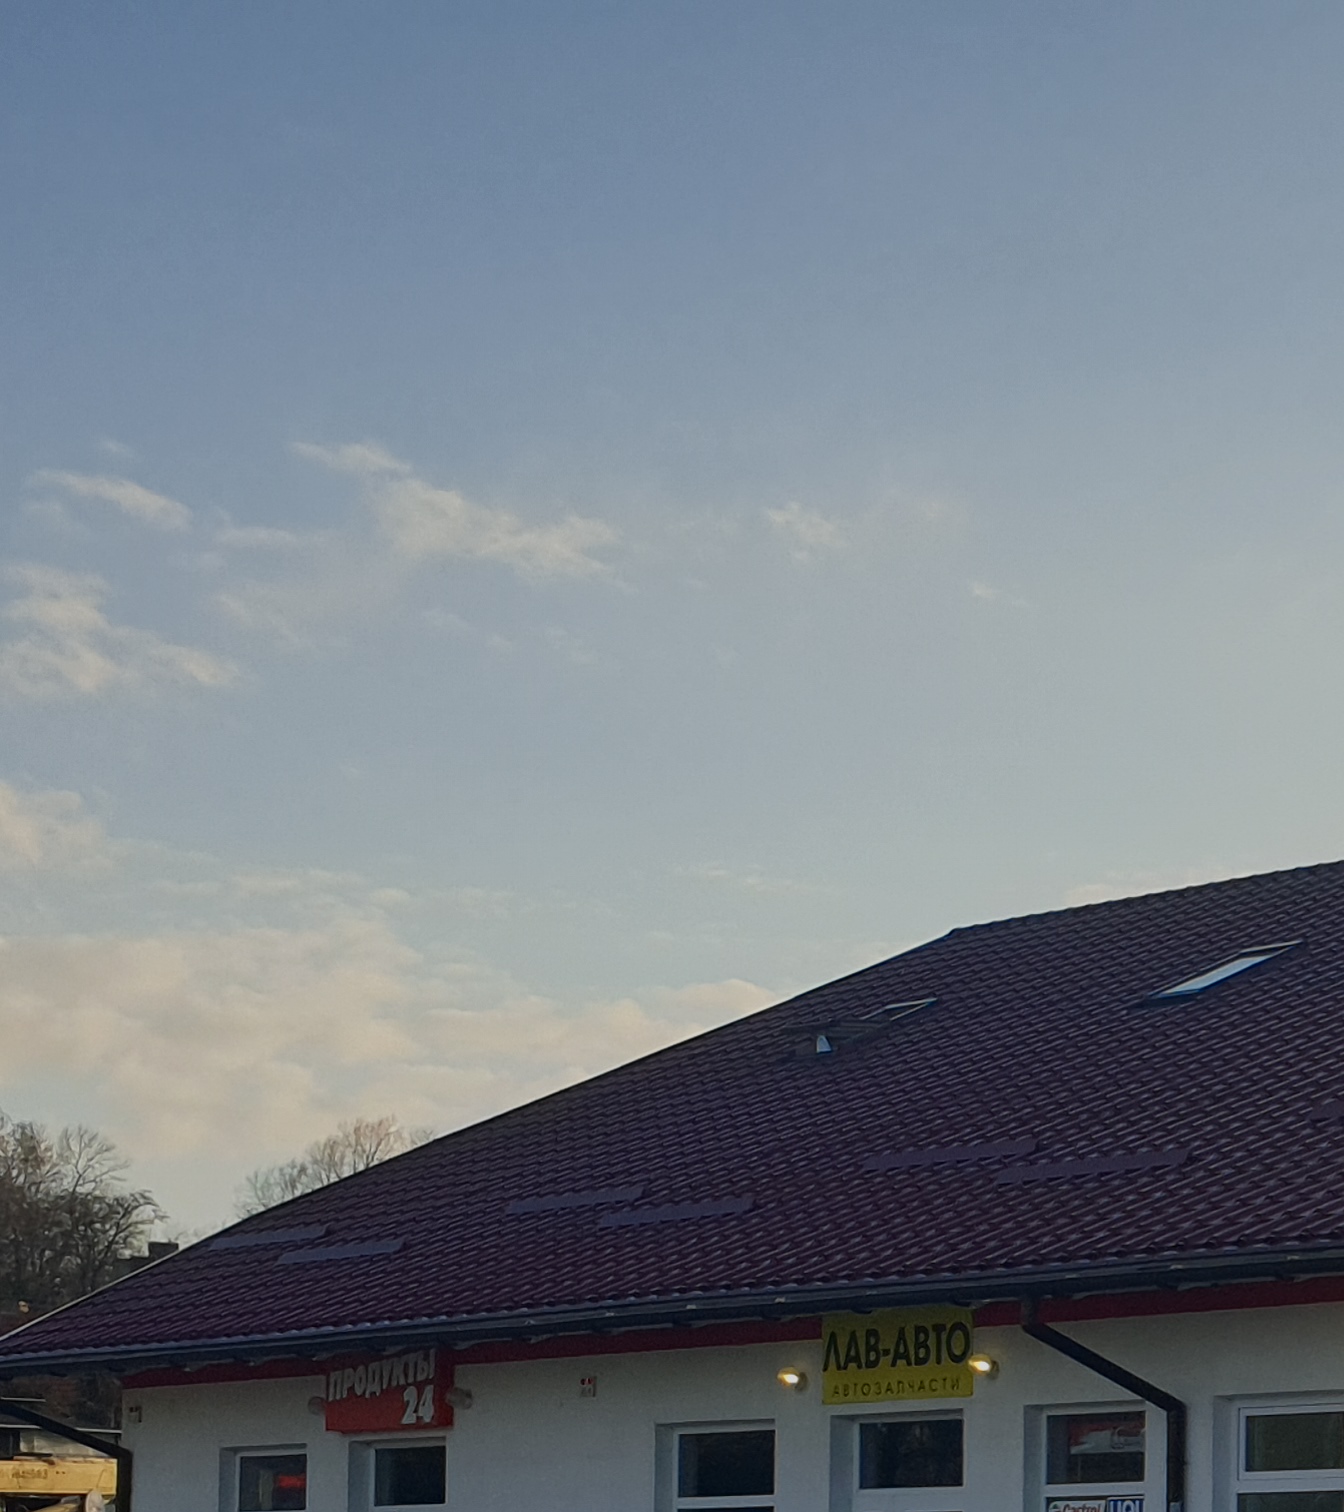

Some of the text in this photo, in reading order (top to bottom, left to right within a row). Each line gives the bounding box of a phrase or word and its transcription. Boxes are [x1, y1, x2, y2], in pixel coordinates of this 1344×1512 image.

[822, 1321, 971, 1372] ЛАВ-АВТО
[327, 1348, 437, 1403] ПРОДУКТЫ
[831, 1376, 961, 1398] АВТОЗАПЧАСТИ
[400, 1384, 436, 1425] 24
